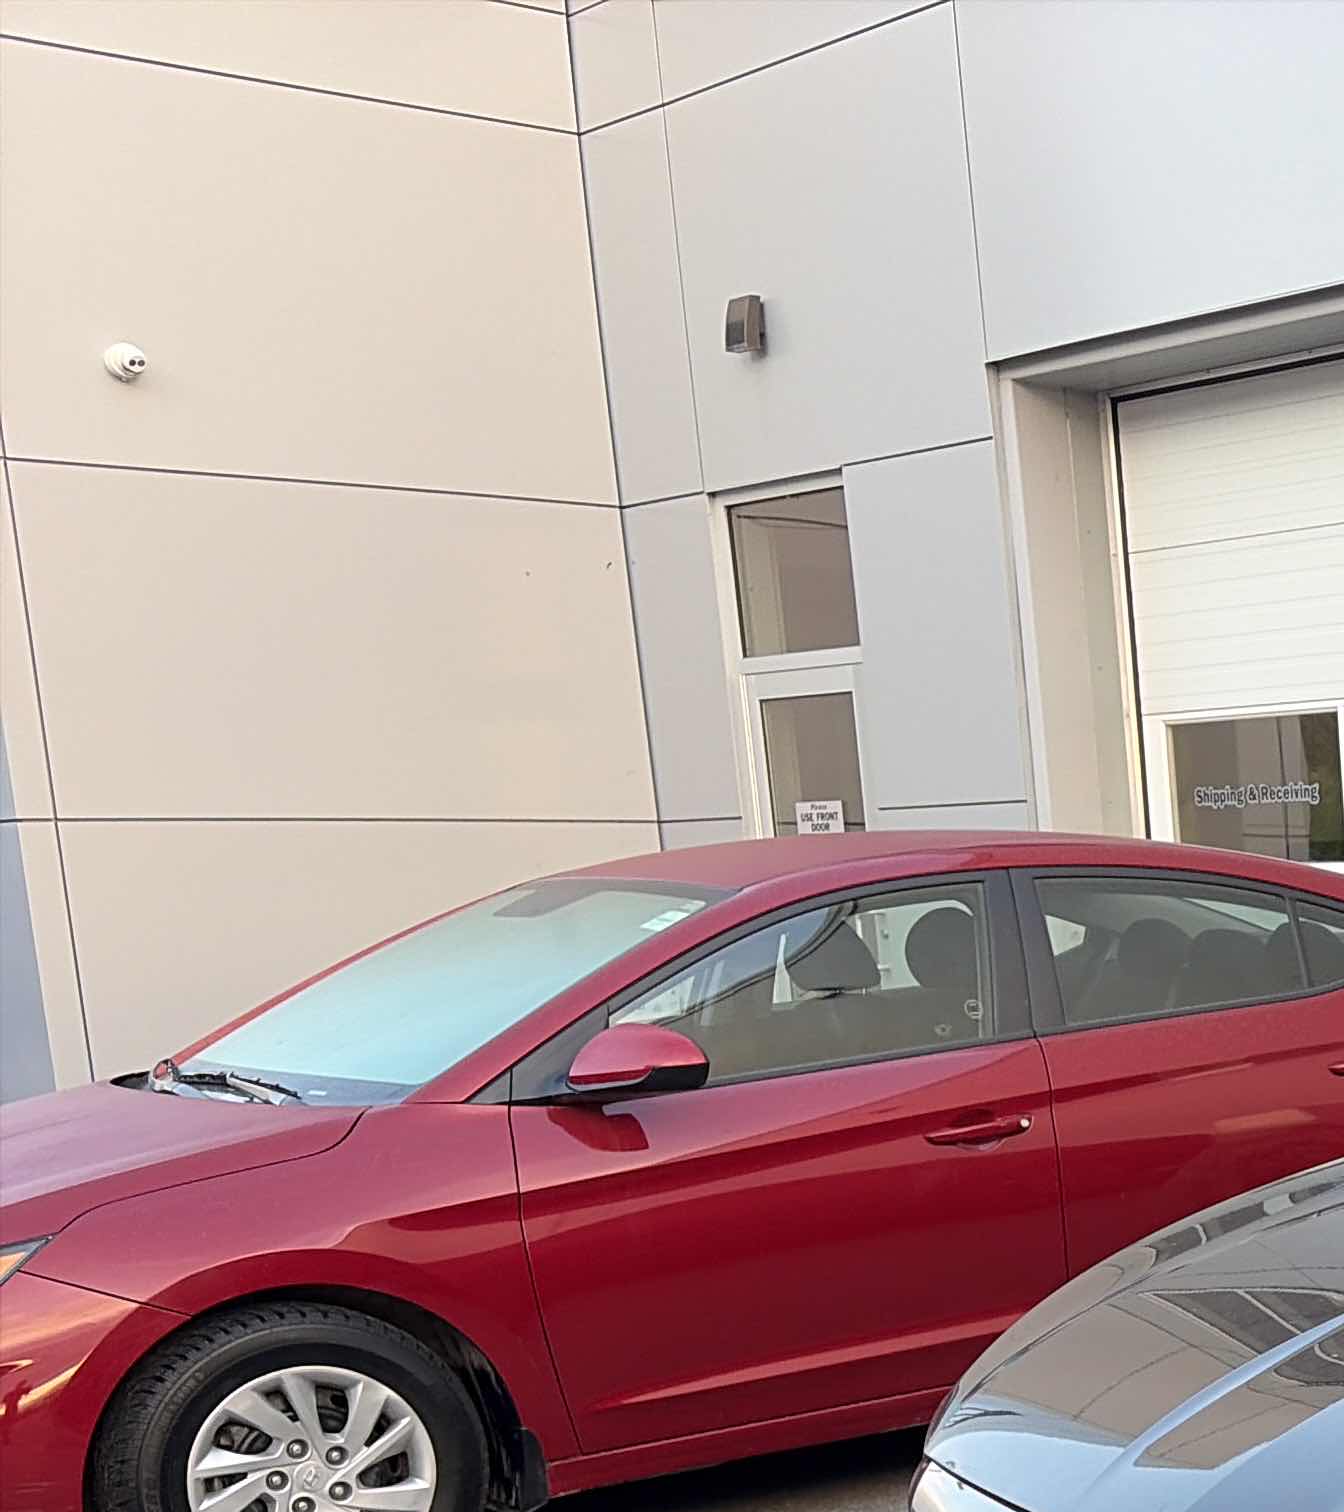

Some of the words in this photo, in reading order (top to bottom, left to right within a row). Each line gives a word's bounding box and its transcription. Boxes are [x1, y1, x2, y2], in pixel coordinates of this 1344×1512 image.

[1195, 786, 1246, 808] Shipping
[1247, 784, 1258, 803] &
[1260, 782, 1319, 804] Receiving
[800, 812, 814, 822] USE
[816, 811, 839, 821] FRONT
[811, 822, 831, 832] DOOR
